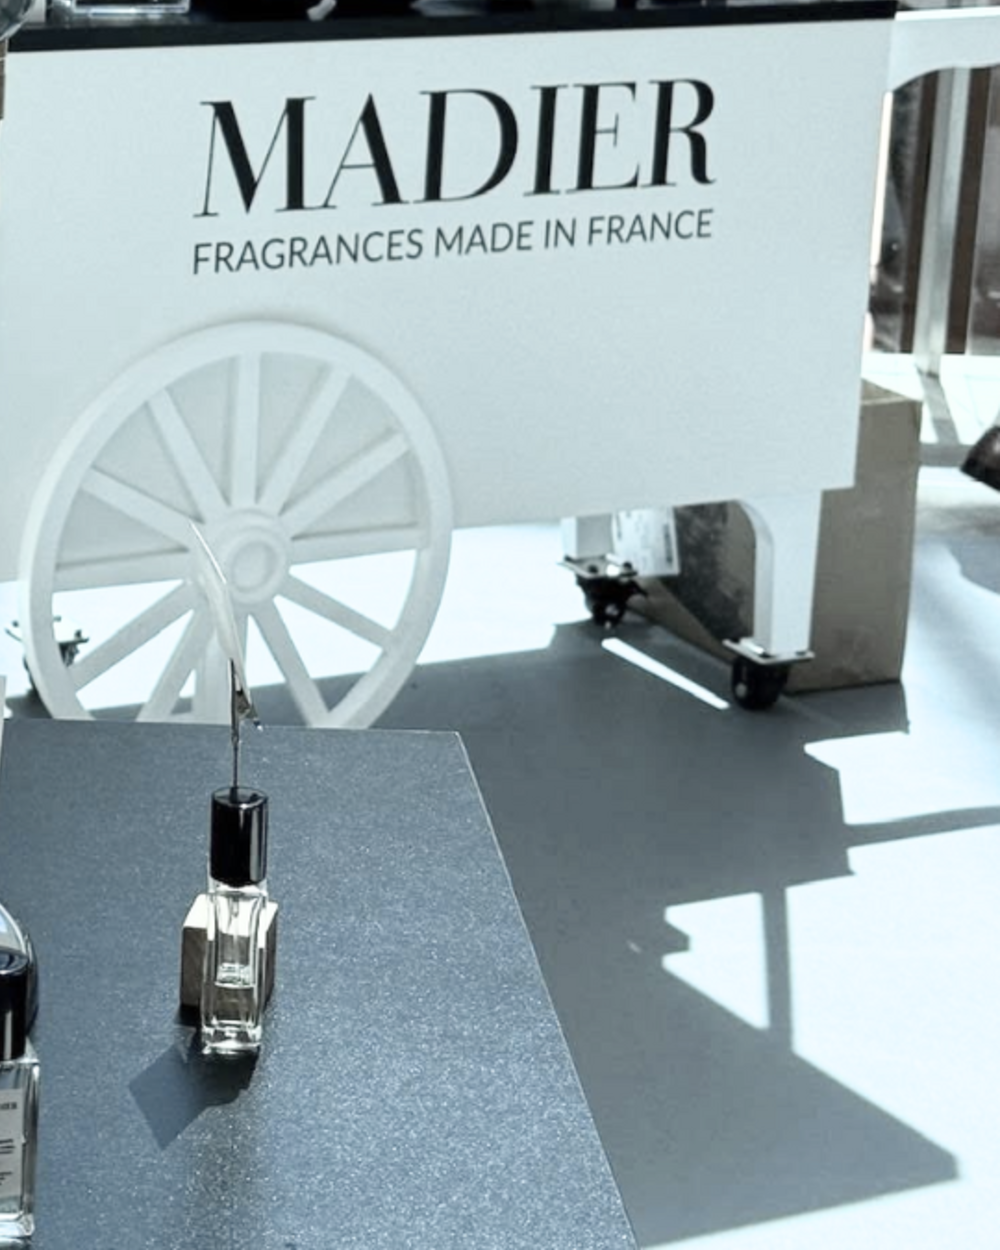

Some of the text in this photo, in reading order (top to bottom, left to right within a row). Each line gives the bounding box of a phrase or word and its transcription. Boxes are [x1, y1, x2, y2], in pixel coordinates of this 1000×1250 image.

[192, 78, 717, 217] MADIER
[193, 208, 714, 275] FRAGRANCES MADE IN FRANCE
